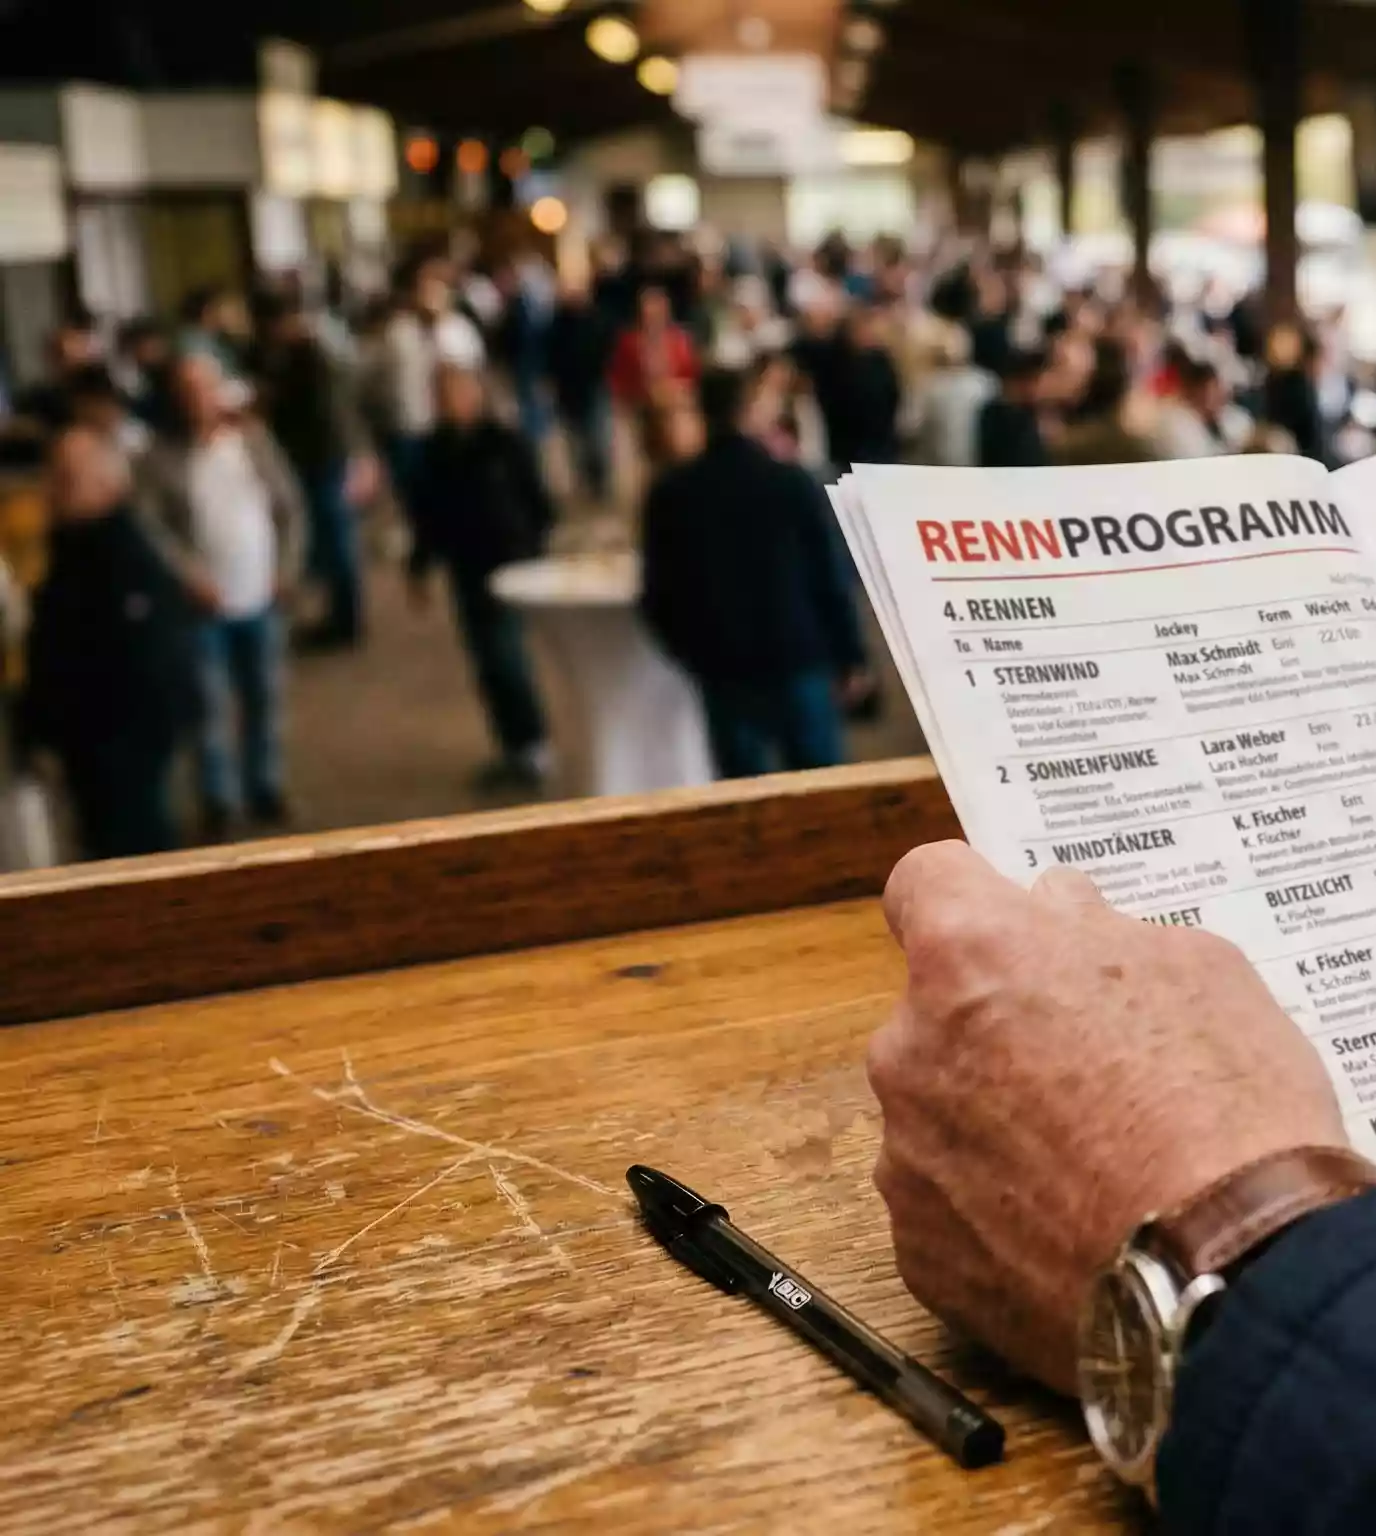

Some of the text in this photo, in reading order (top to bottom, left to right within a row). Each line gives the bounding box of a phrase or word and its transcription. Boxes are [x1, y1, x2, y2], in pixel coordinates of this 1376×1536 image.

[916, 500, 1352, 563] RENNPROGRAMM
[943, 597, 1056, 621] 4. RENNEN
[982, 637, 1023, 652] Name
[1154, 622, 1199, 639] Jockey
[1258, 609, 1292, 622] Form
[1166, 648, 1200, 667] Max
[1201, 639, 1262, 662] Schmidt
[965, 661, 1099, 687] 1 STERNWIND
[1173, 671, 1200, 684] Max
[1200, 728, 1286, 755] Lara Weber
[996, 748, 1159, 783] 2 SONNENFUNKE
[1208, 759, 1235, 773] Lara
[1233, 804, 1307, 831] K. Fischer
[1024, 828, 1176, 867] 3 WINDTÄNZER
[1265, 874, 1353, 908] BLITZLICHT
[1296, 947, 1373, 977] K. Fischer
